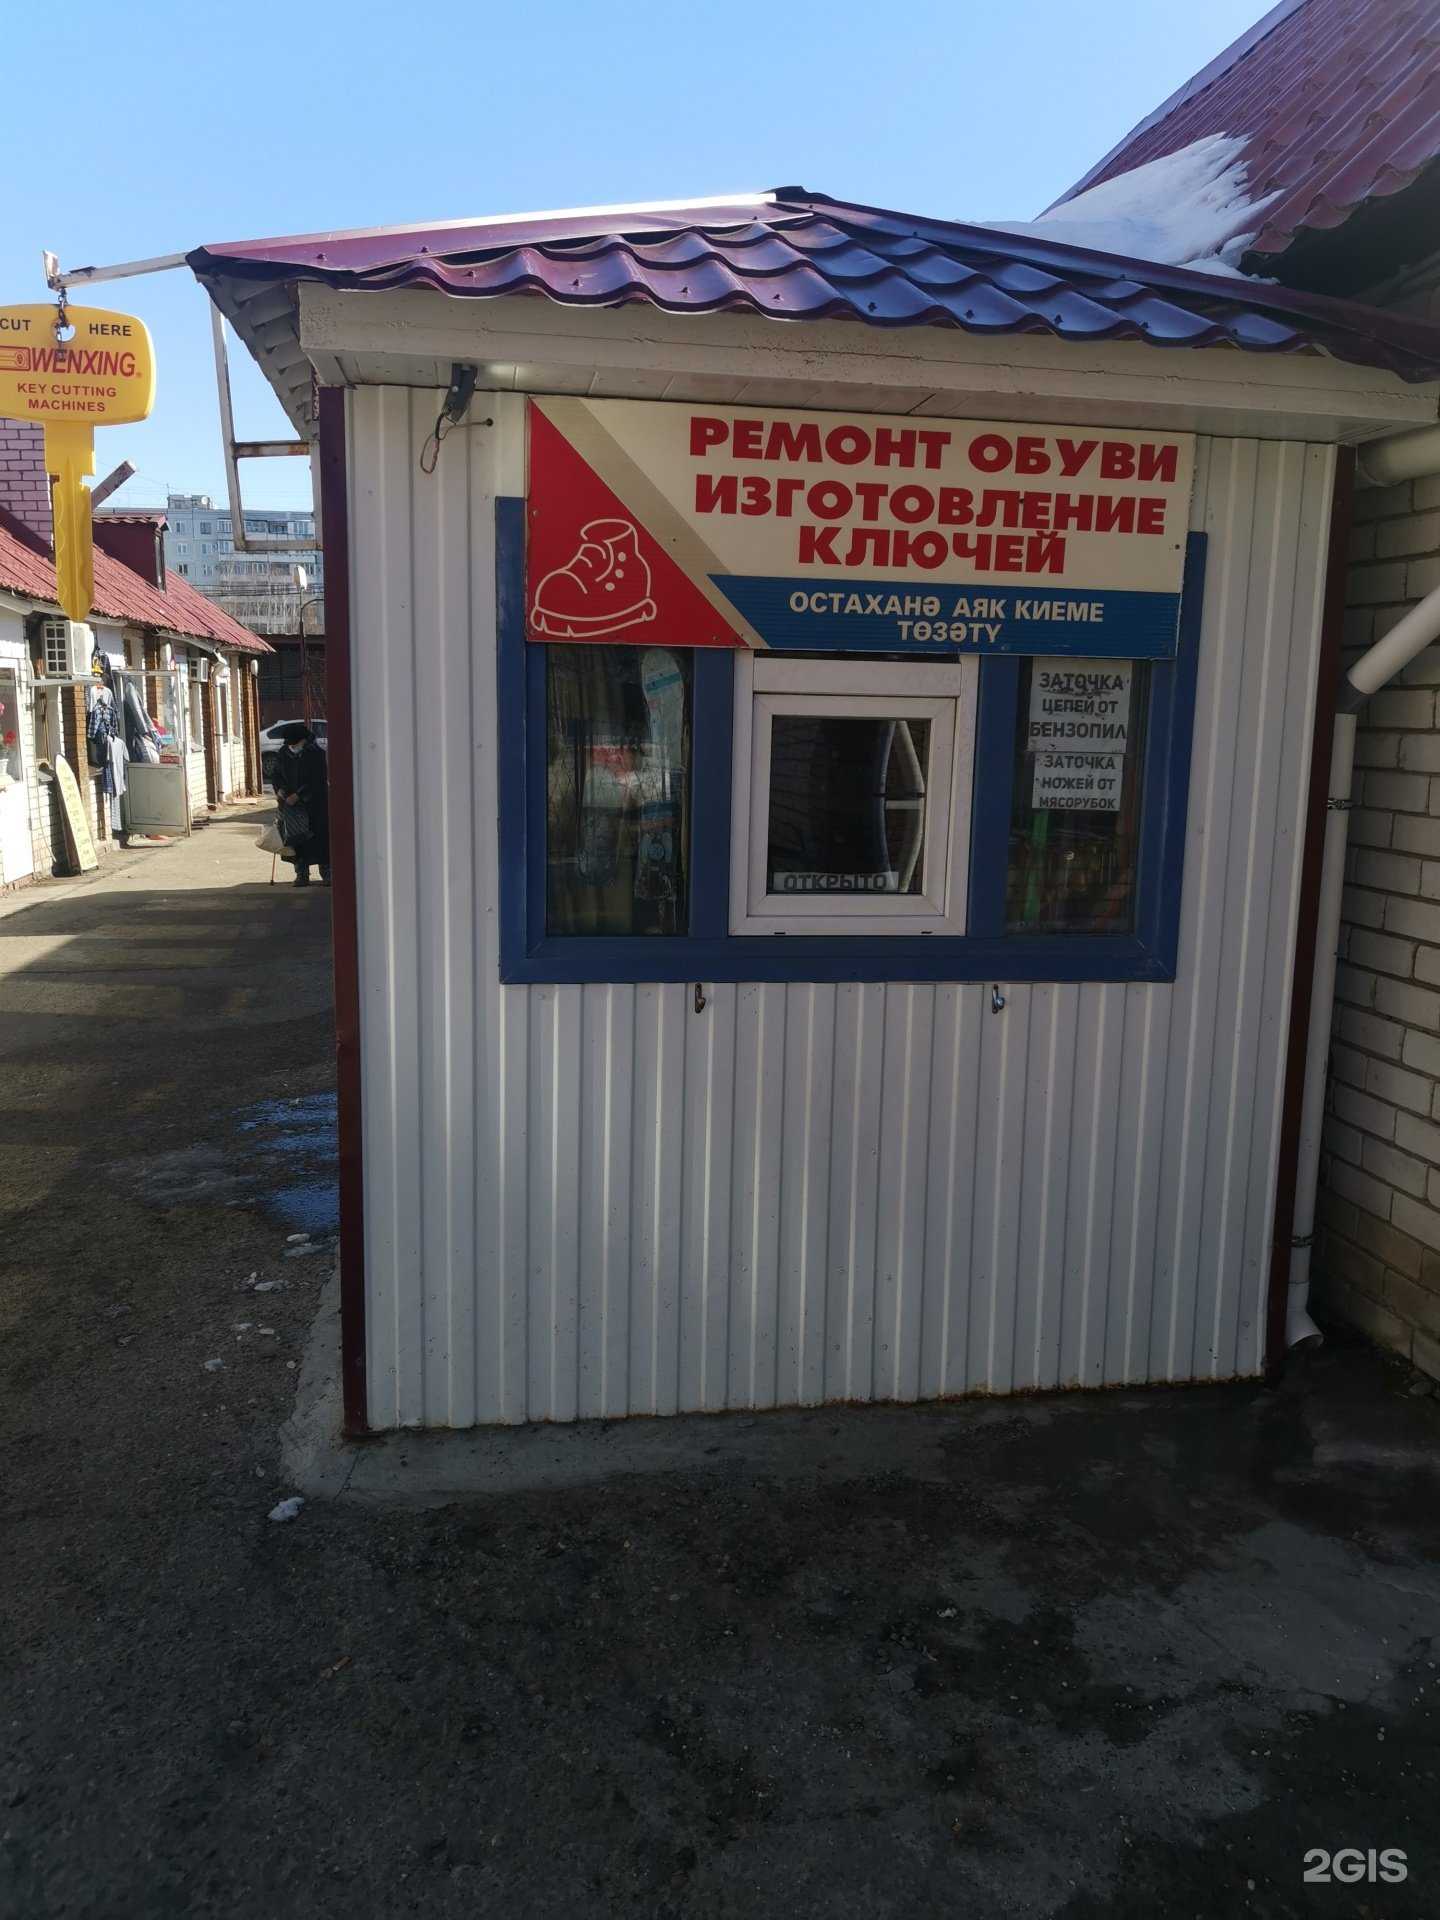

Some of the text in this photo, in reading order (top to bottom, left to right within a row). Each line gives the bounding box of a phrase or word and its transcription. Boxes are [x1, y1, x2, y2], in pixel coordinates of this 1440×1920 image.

[0, 318, 132, 336] CUT HERE
[31, 347, 136, 377] WENXING
[17, 383, 117, 397] KEY CUTTING
[28, 399, 106, 412] MACHINES
[690, 416, 1179, 482] РЕМОНТ ОБУВИ
[695, 474, 1167, 535] ИЗГОТОВЛЕНИЕ
[798, 525, 1066, 574] КЛЮЧЕЙ
[789, 591, 1104, 623] ОСТАХАНӘ АЯК КИЕМЕ
[1039, 672, 1124, 691] ЗАТОЧКА
[1042, 696, 1119, 715] ЦЕПЕЙ ОТ
[1029, 721, 1126, 740] БЕНЗОПИЛ
[1044, 755, 1116, 770] ЗАТОЧКА
[1041, 774, 1116, 791] НОЖЕЙ ОТ
[1039, 796, 1116, 809] МЯСОРУБОК
[784, 874, 887, 891] ОТКРЫТО
